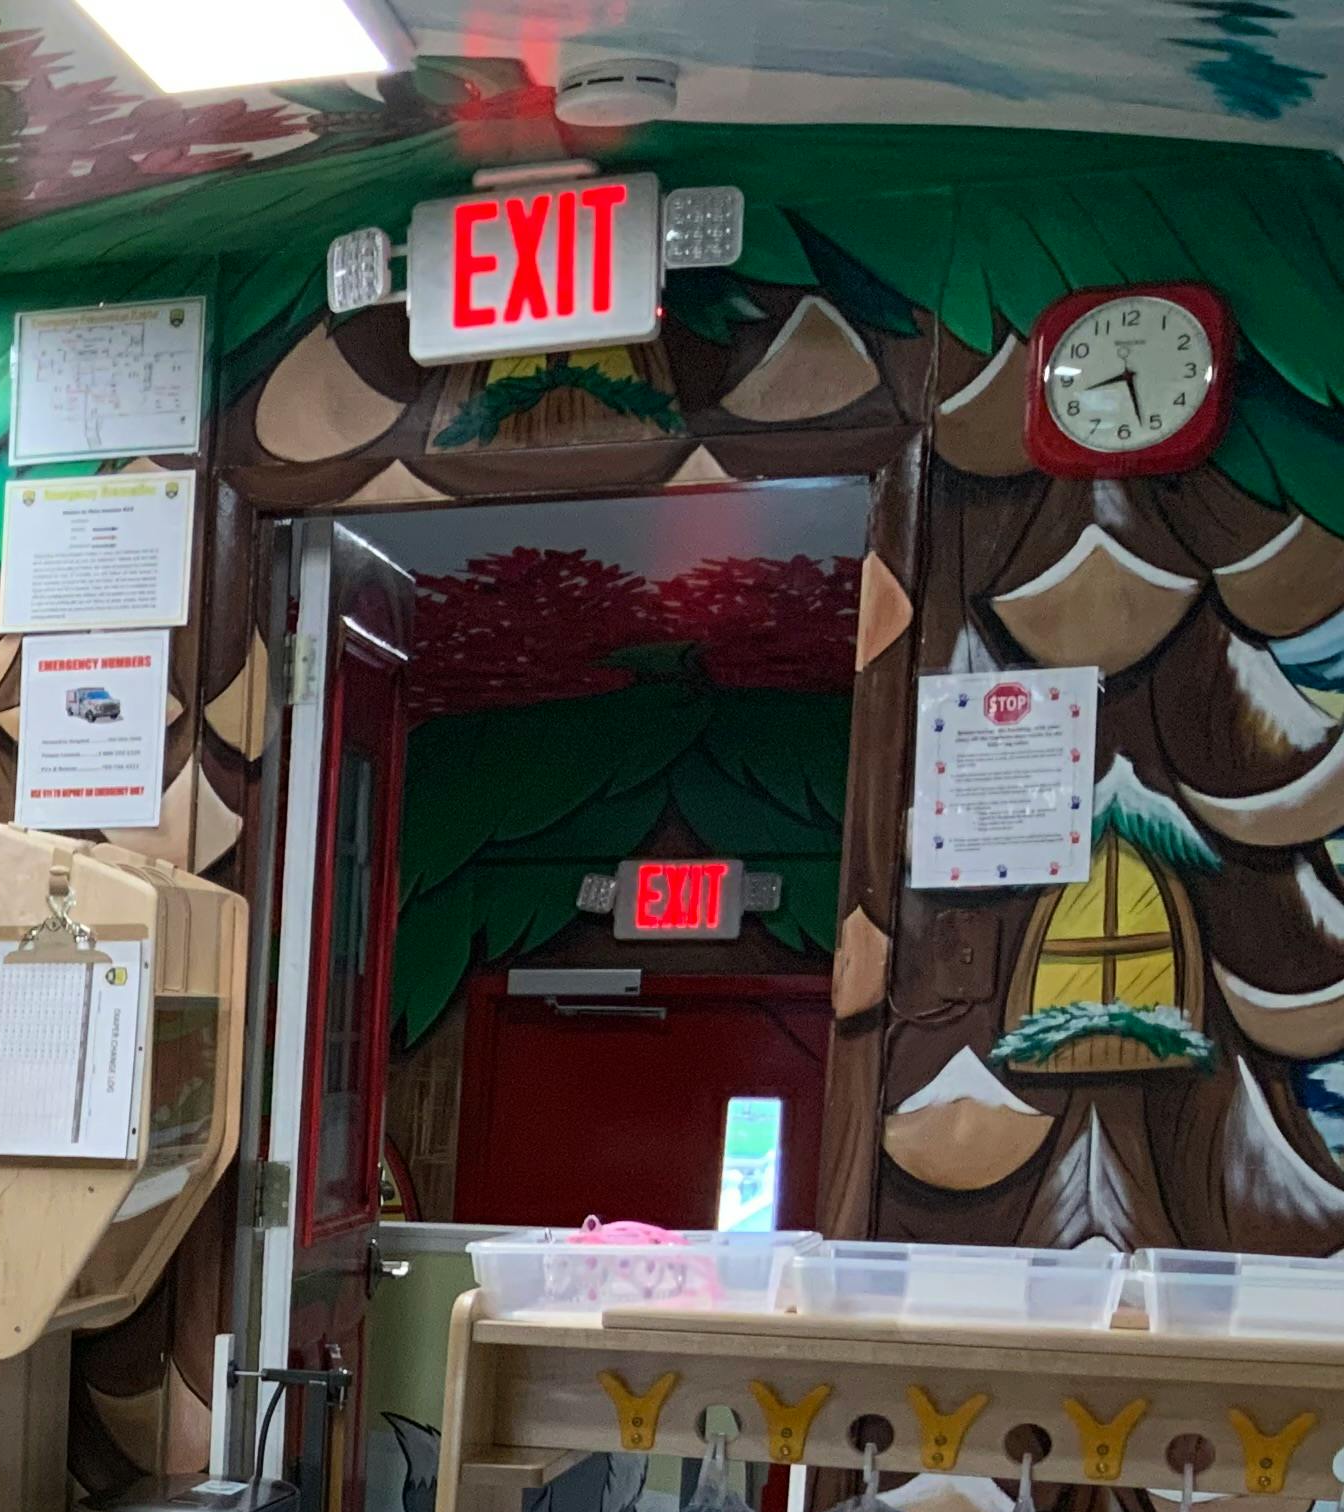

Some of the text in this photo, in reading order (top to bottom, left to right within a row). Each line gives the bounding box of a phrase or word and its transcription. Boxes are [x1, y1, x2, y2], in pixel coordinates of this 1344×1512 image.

[452, 184, 627, 329] EXIT
[1122, 310, 1141, 327] 12
[1161, 315, 1167, 331] 1
[1094, 320, 1110, 336] 11
[1070, 343, 1090, 359] 10
[1177, 334, 1191, 351] 2
[1184, 362, 1197, 379] 3
[1173, 392, 1186, 407] 4
[1067, 400, 1080, 417] 8
[1089, 418, 1102, 435] 7
[1149, 414, 1163, 430] 5
[1117, 424, 1132, 440] 6
[38, 655, 152, 672] EMERGENCY NUMBERS
[988, 694, 1027, 718] STOP
[635, 863, 729, 930] EXIT
